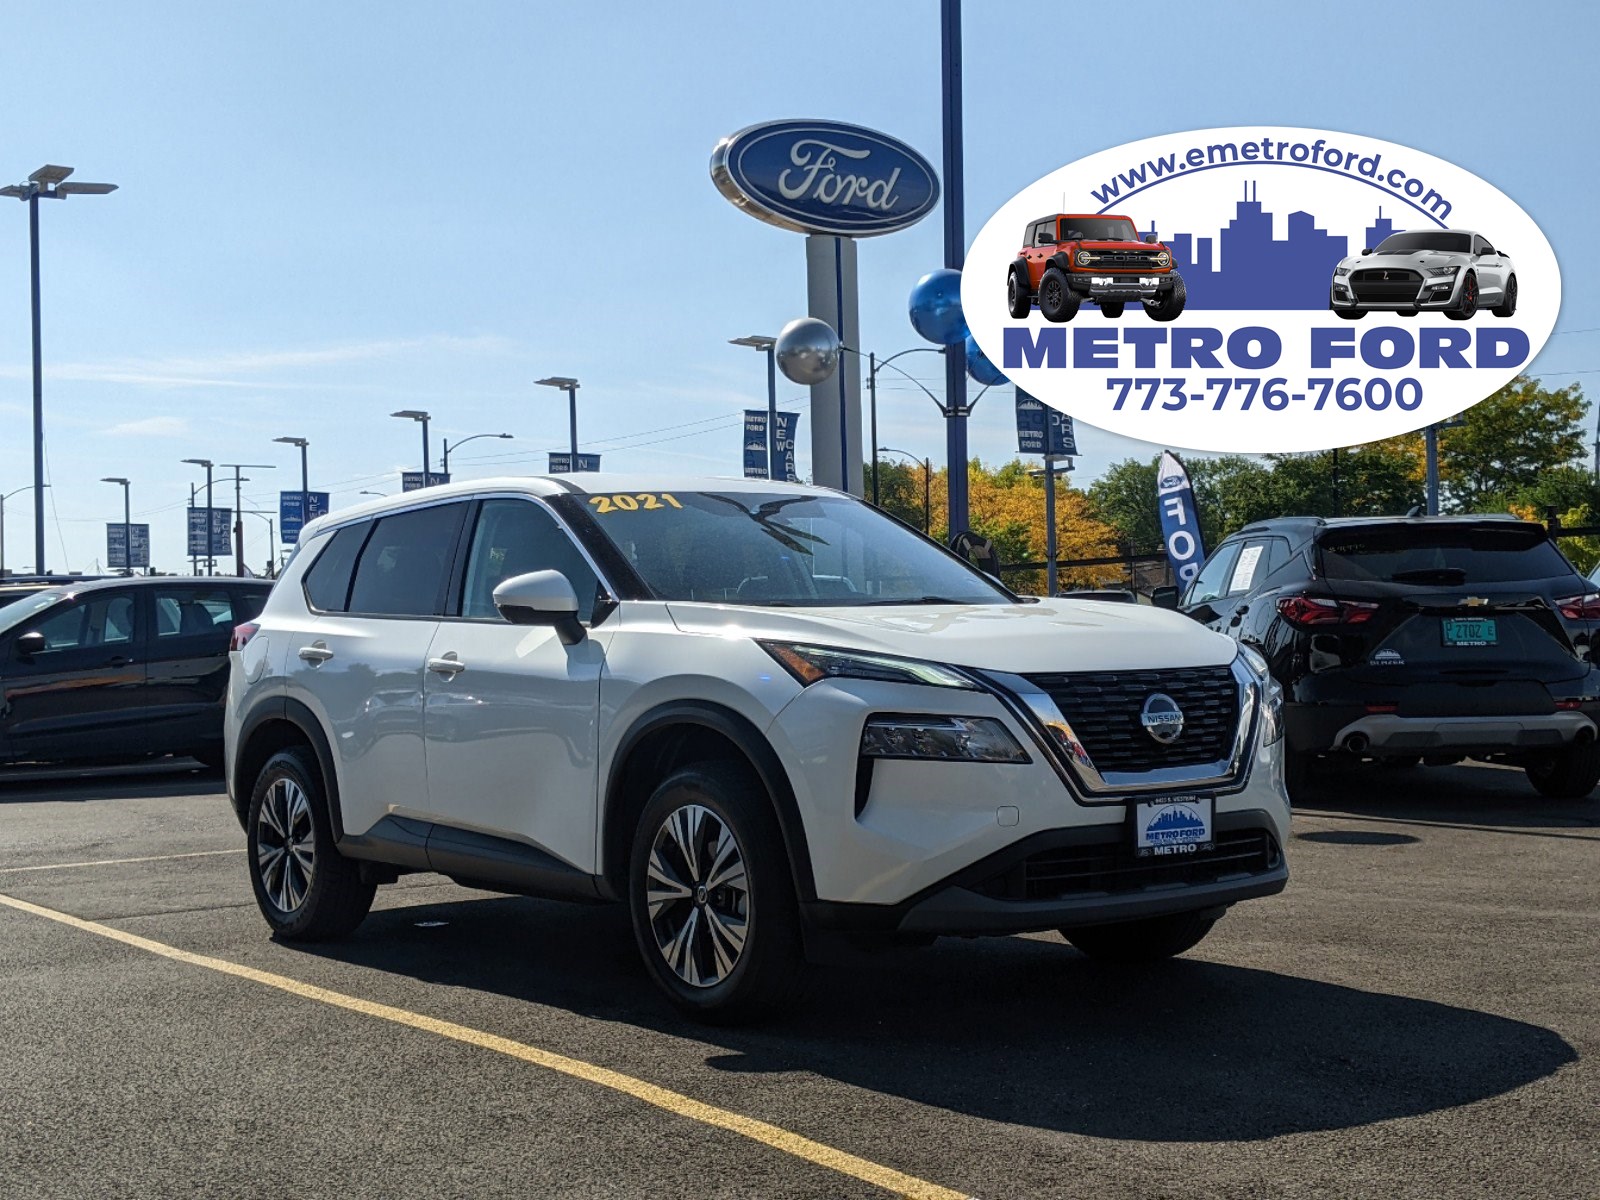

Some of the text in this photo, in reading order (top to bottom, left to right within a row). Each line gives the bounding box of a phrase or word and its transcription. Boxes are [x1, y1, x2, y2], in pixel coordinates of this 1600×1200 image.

[778, 139, 900, 210] Ford
[1018, 430, 1044, 438] METRO
[1021, 440, 1042, 448] FORD
[589, 493, 683, 513] 2021
[1456, 624, 1482, 639] 2702
[1147, 712, 1181, 723] NISSAN
[1154, 843, 1197, 856] METRO
